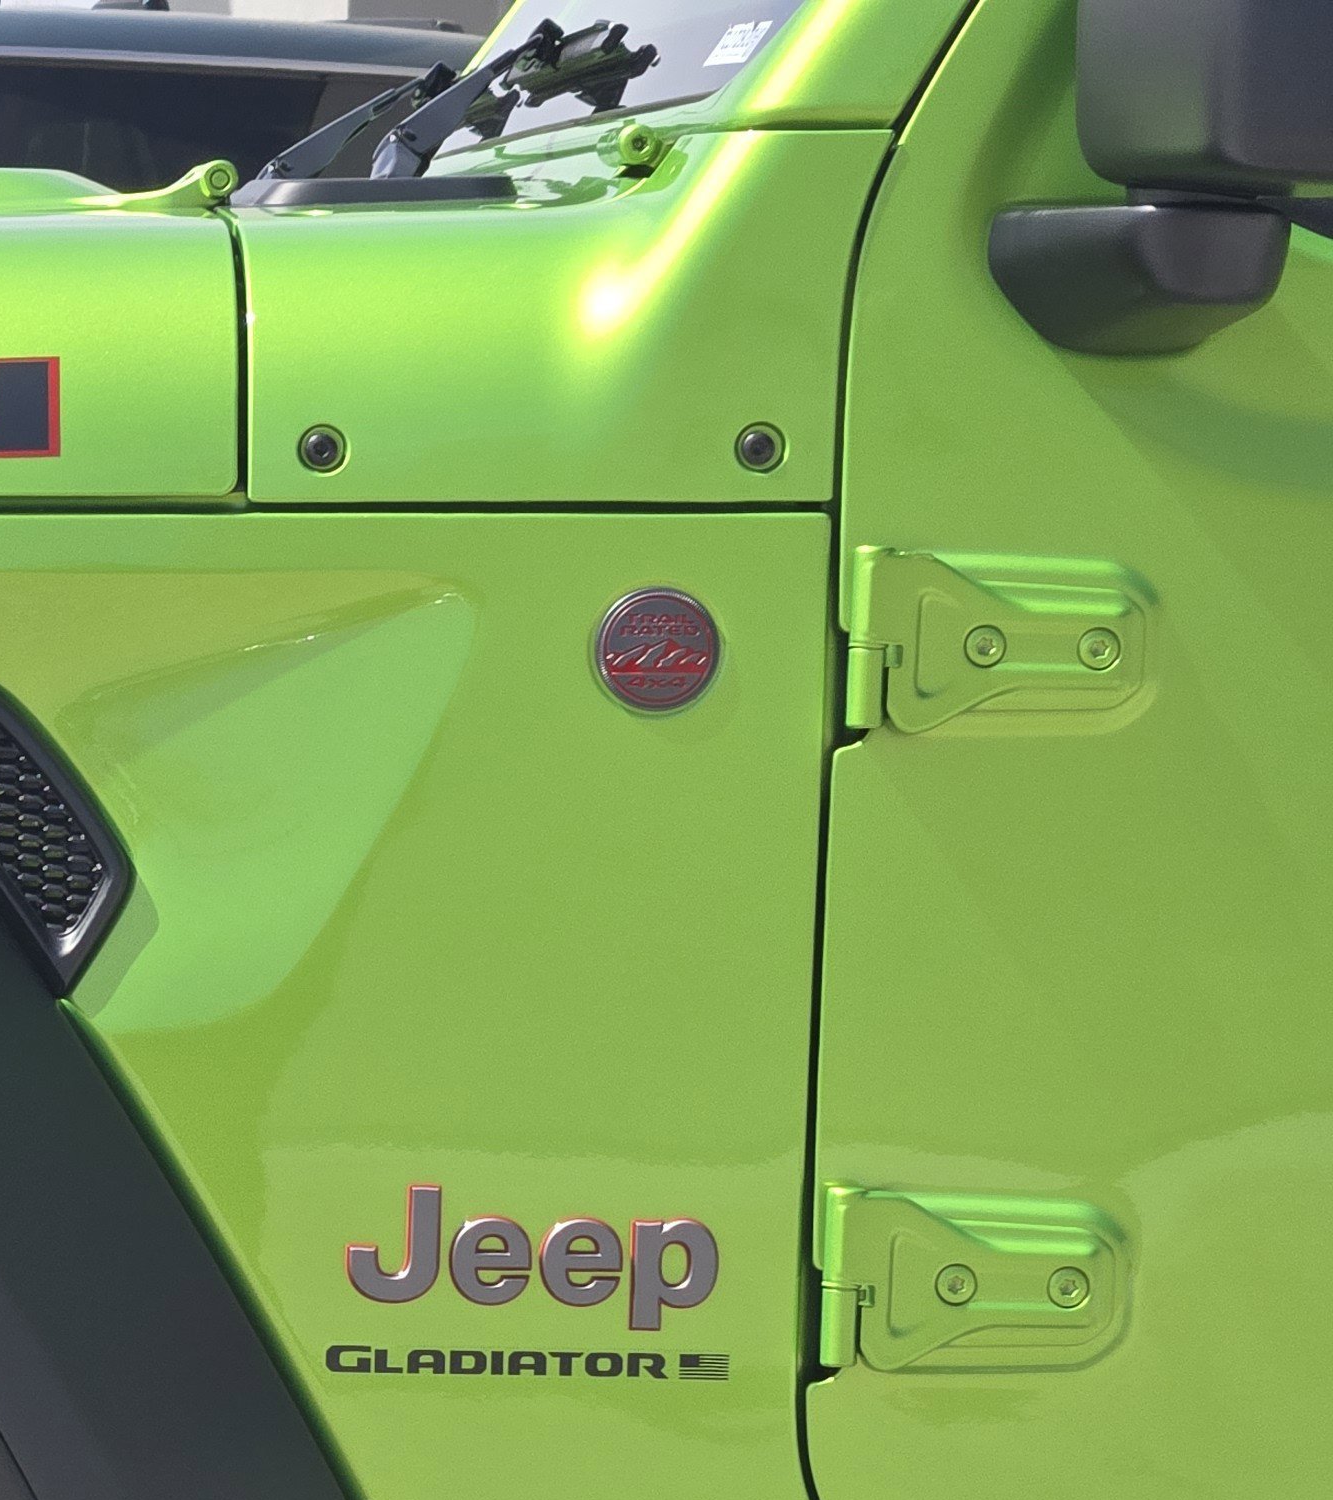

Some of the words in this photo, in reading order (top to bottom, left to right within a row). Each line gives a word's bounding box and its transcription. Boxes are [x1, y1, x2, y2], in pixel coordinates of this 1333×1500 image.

[619, 624, 700, 637] RATED
[628, 613, 694, 625] TRAIL
[345, 1183, 719, 1331] Jeep
[325, 1345, 668, 1379] GLADIATOR
